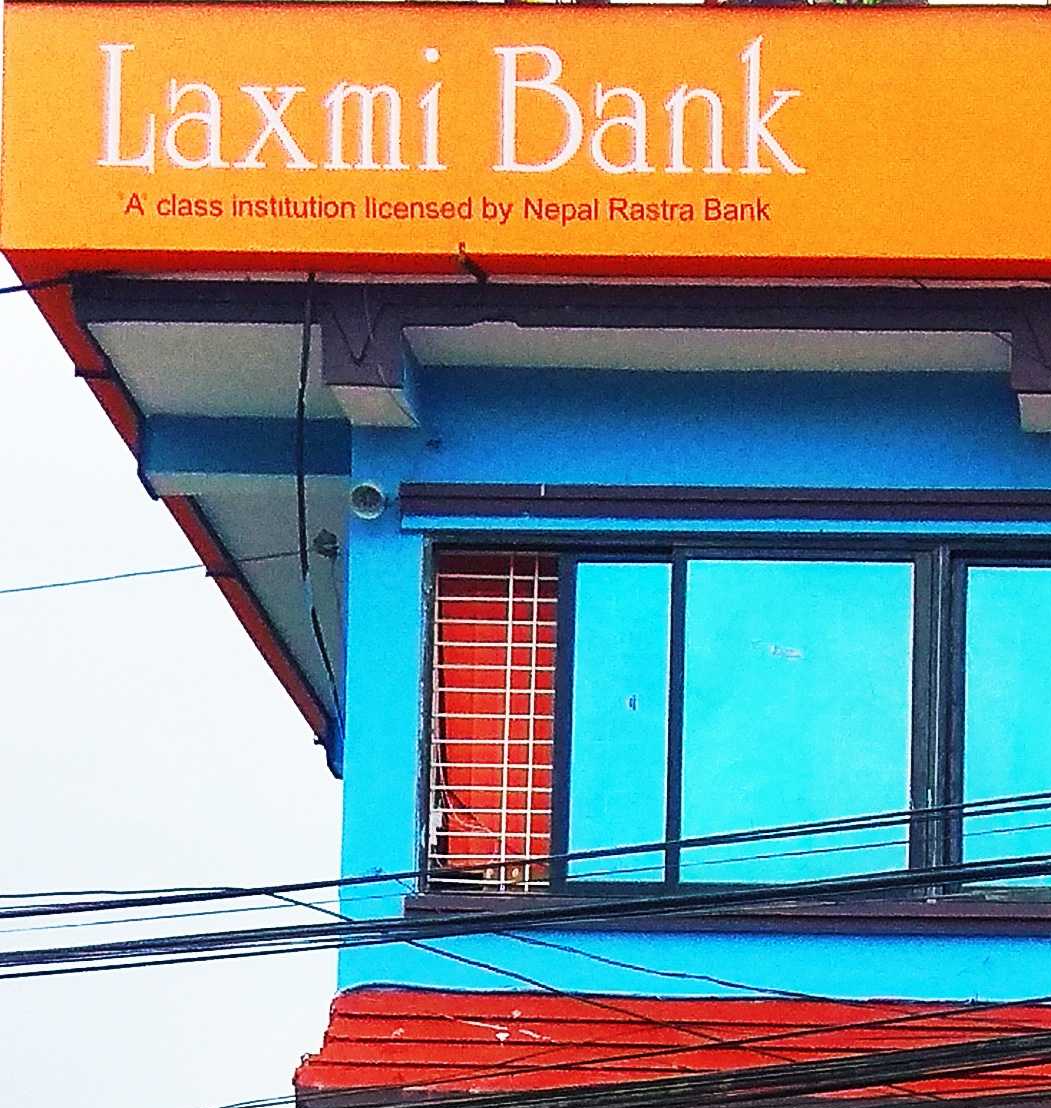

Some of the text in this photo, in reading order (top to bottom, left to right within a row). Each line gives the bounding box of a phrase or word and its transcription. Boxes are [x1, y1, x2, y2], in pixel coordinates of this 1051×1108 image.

[97, 35, 807, 176] Laxmi Bank
[156, 193, 224, 217] class
[231, 194, 357, 219] institution
[364, 195, 473, 220] licensed
[481, 196, 513, 225] by
[523, 197, 599, 226] Nepal
[608, 197, 695, 222] Rastra
[703, 198, 771, 222] Bank
